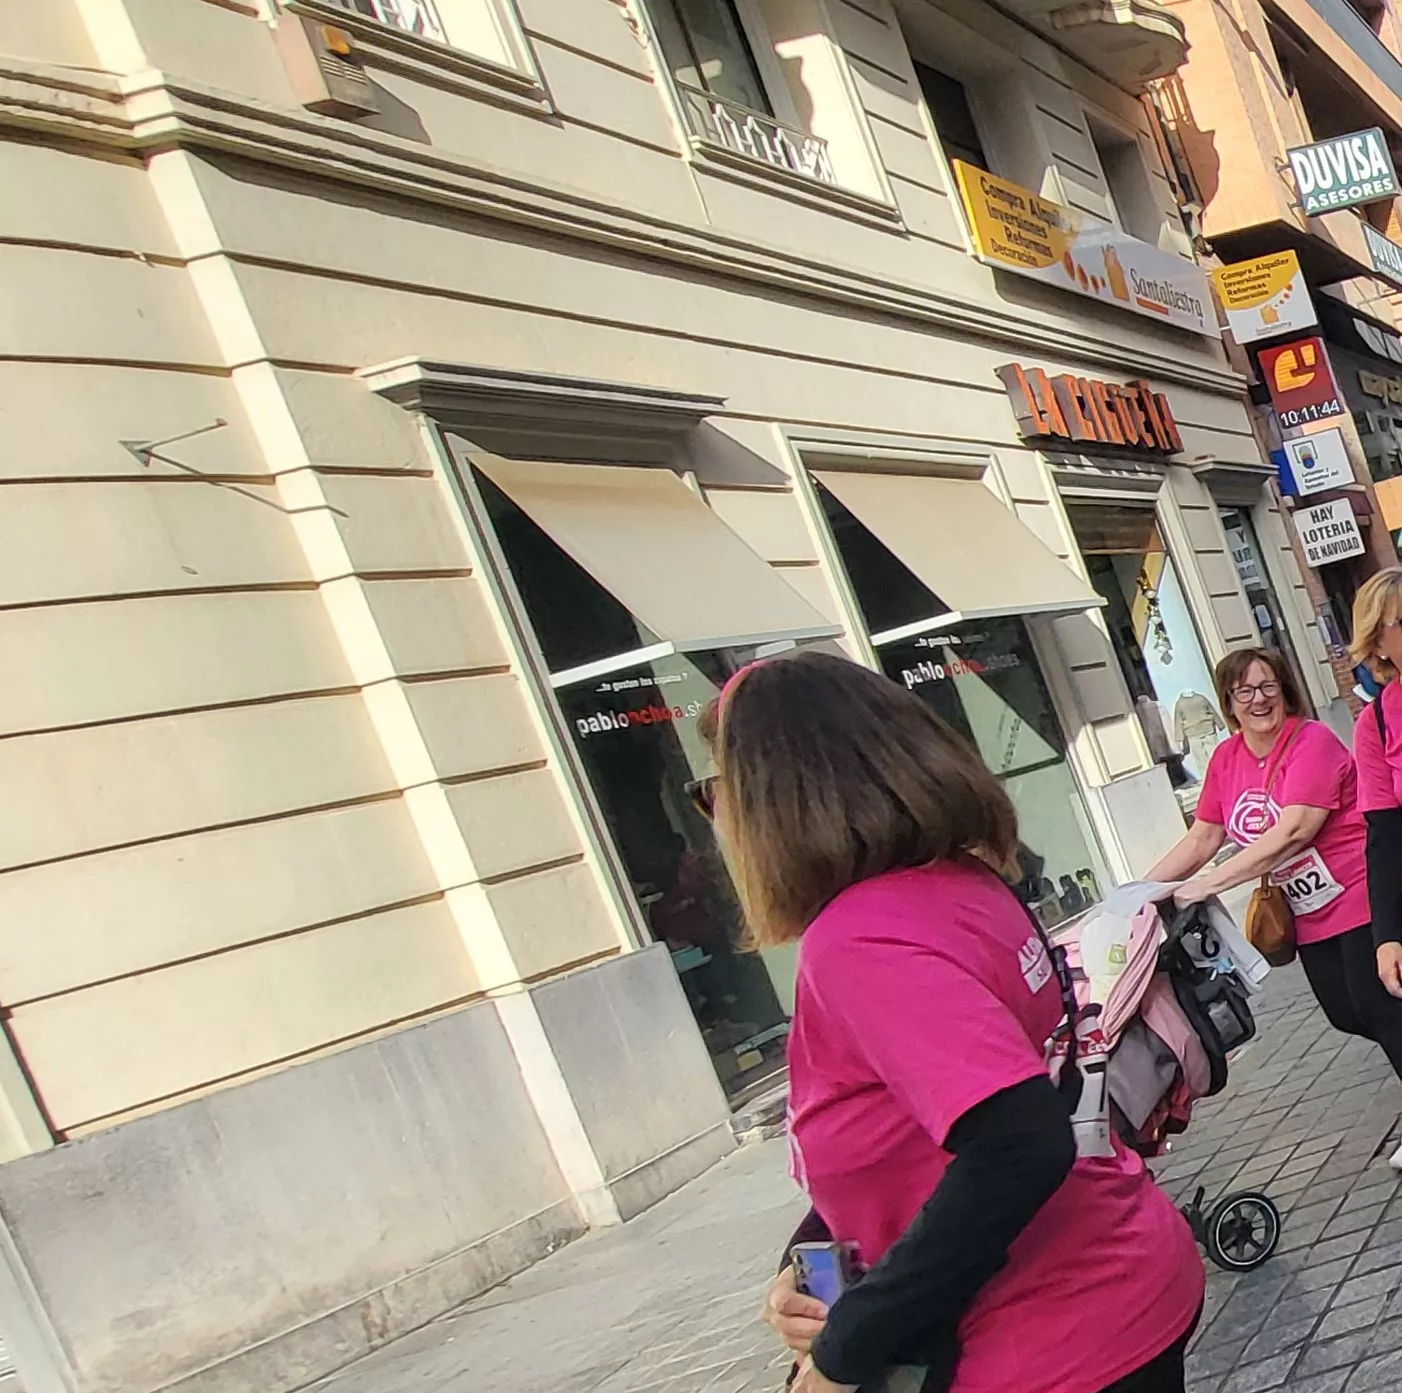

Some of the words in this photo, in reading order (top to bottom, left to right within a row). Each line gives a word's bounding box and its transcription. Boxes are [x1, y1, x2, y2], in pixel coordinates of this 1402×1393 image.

[1290, 134, 1390, 195] DUVISA
[979, 176, 1025, 211] Compra
[1307, 178, 1394, 210] ASESORES
[987, 199, 1048, 240] Inversiones
[990, 236, 1038, 267] Decoración
[1003, 224, 1054, 259] Reformas
[1220, 267, 1253, 281] Compra
[1255, 258, 1289, 271] Alquiler
[1223, 272, 1271, 289] Inversiones
[1129, 267, 1205, 318] Santaliestra
[1227, 282, 1267, 296] Reformas
[998, 363, 1069, 439] LA
[1280, 399, 1341, 426] 10:11:44
[1309, 505, 1335, 524] HAY
[1302, 520, 1355, 545] LOTERIA
[1308, 546, 1319, 561] DE
[1320, 536, 1360, 559] NAVIDAD
